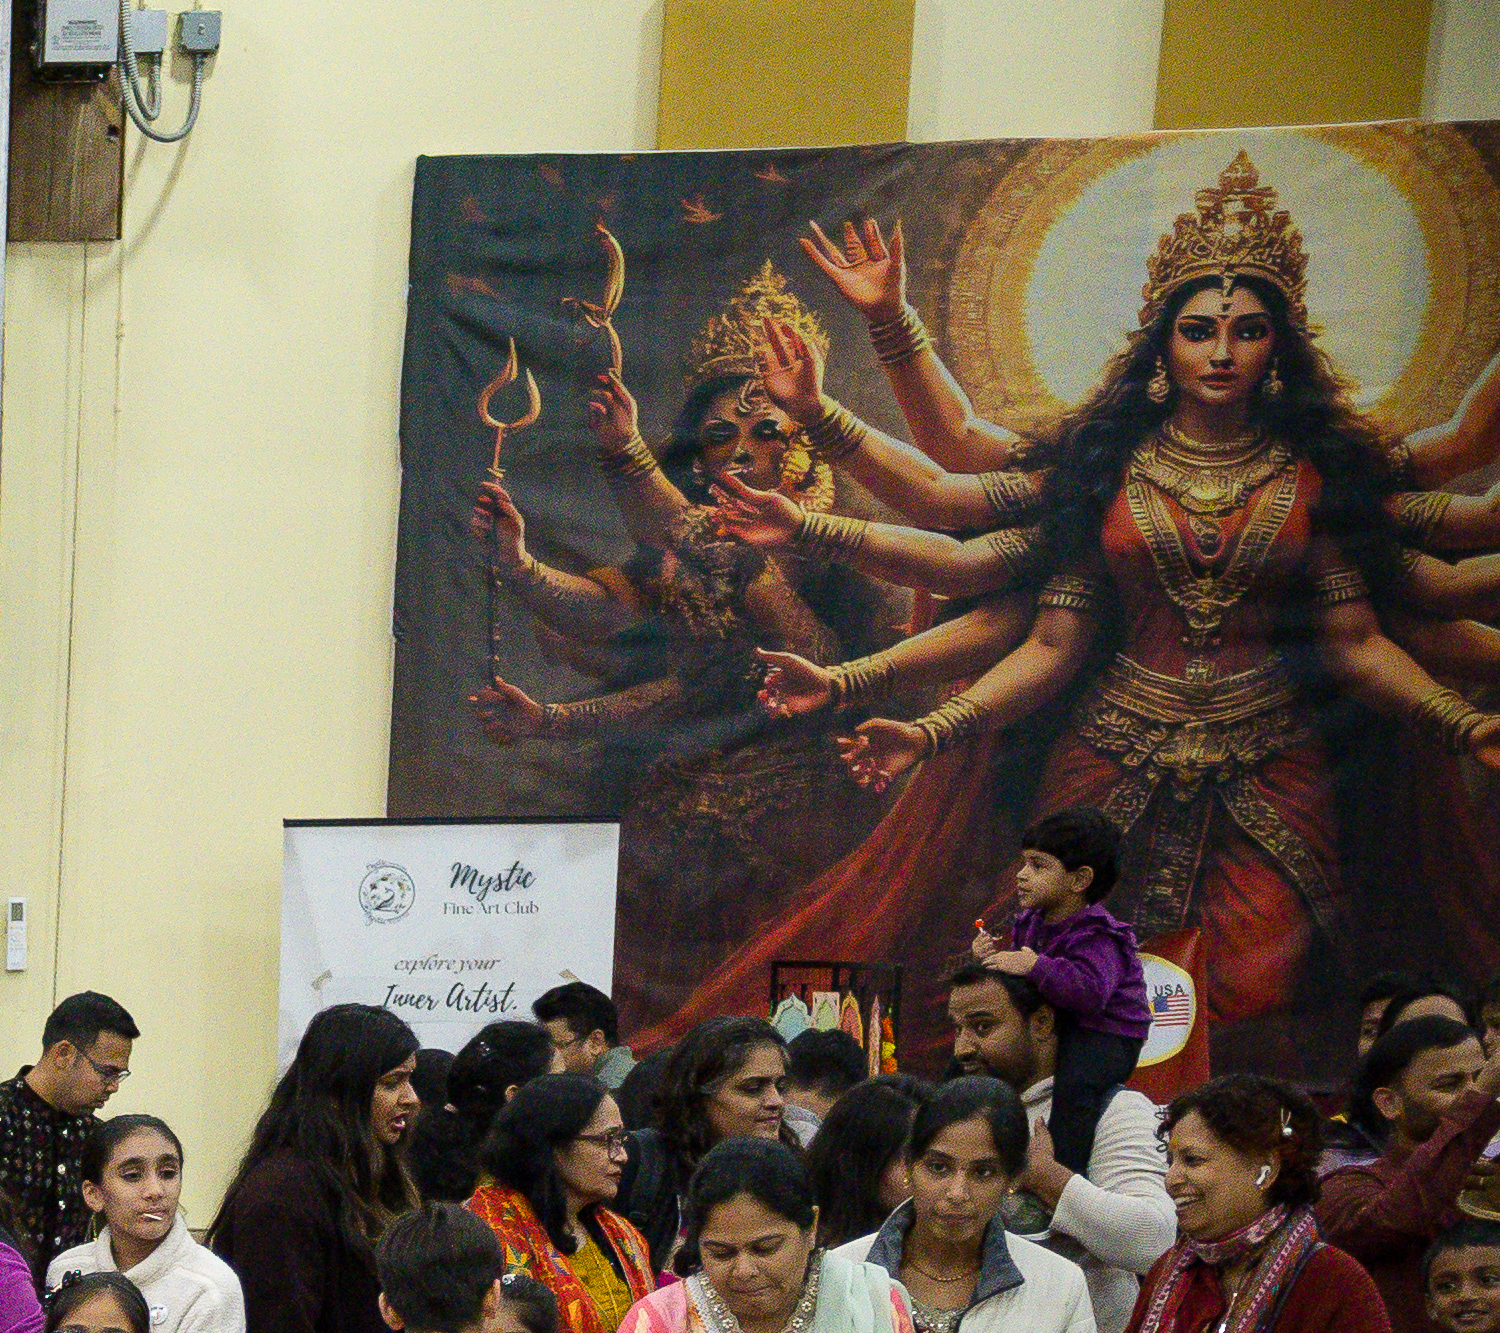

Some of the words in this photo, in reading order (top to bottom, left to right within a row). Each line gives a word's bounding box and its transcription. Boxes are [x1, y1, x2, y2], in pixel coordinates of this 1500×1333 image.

[449, 860, 537, 901] Mystic
[443, 902, 473, 915] Fine
[479, 902, 500, 915] Art
[504, 901, 540, 915] Club
[394, 954, 457, 975] explore
[455, 958, 501, 975] your
[383, 984, 439, 1011] Inner
[445, 982, 518, 1013] Artist.
[1154, 983, 1185, 997] USA
